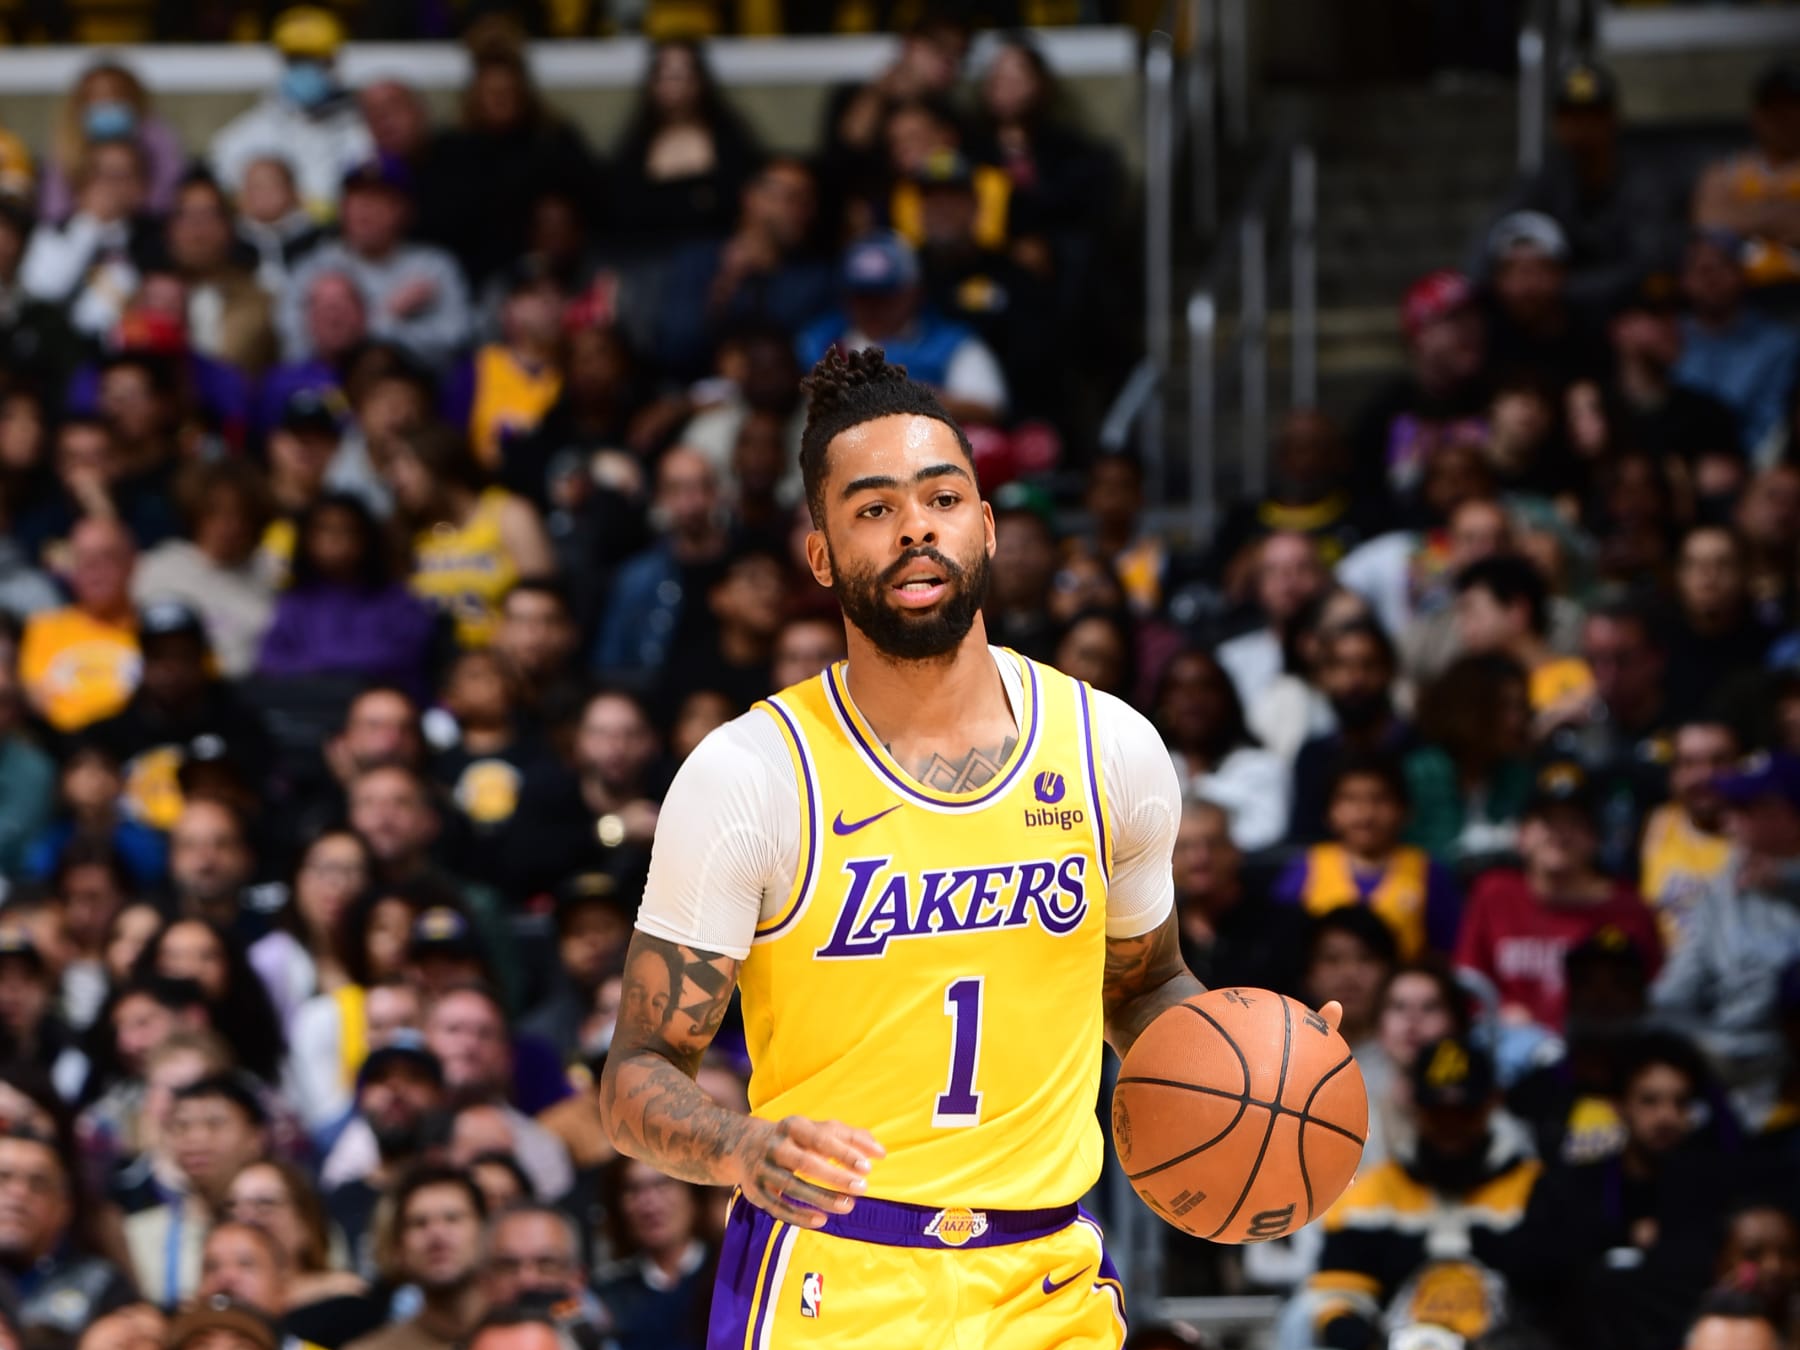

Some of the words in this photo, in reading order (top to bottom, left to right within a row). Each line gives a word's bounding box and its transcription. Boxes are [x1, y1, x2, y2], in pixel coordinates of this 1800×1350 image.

[1024, 807, 1084, 831] bibigo
[814, 855, 1089, 959] LAKERS
[933, 976, 983, 1125] 1
